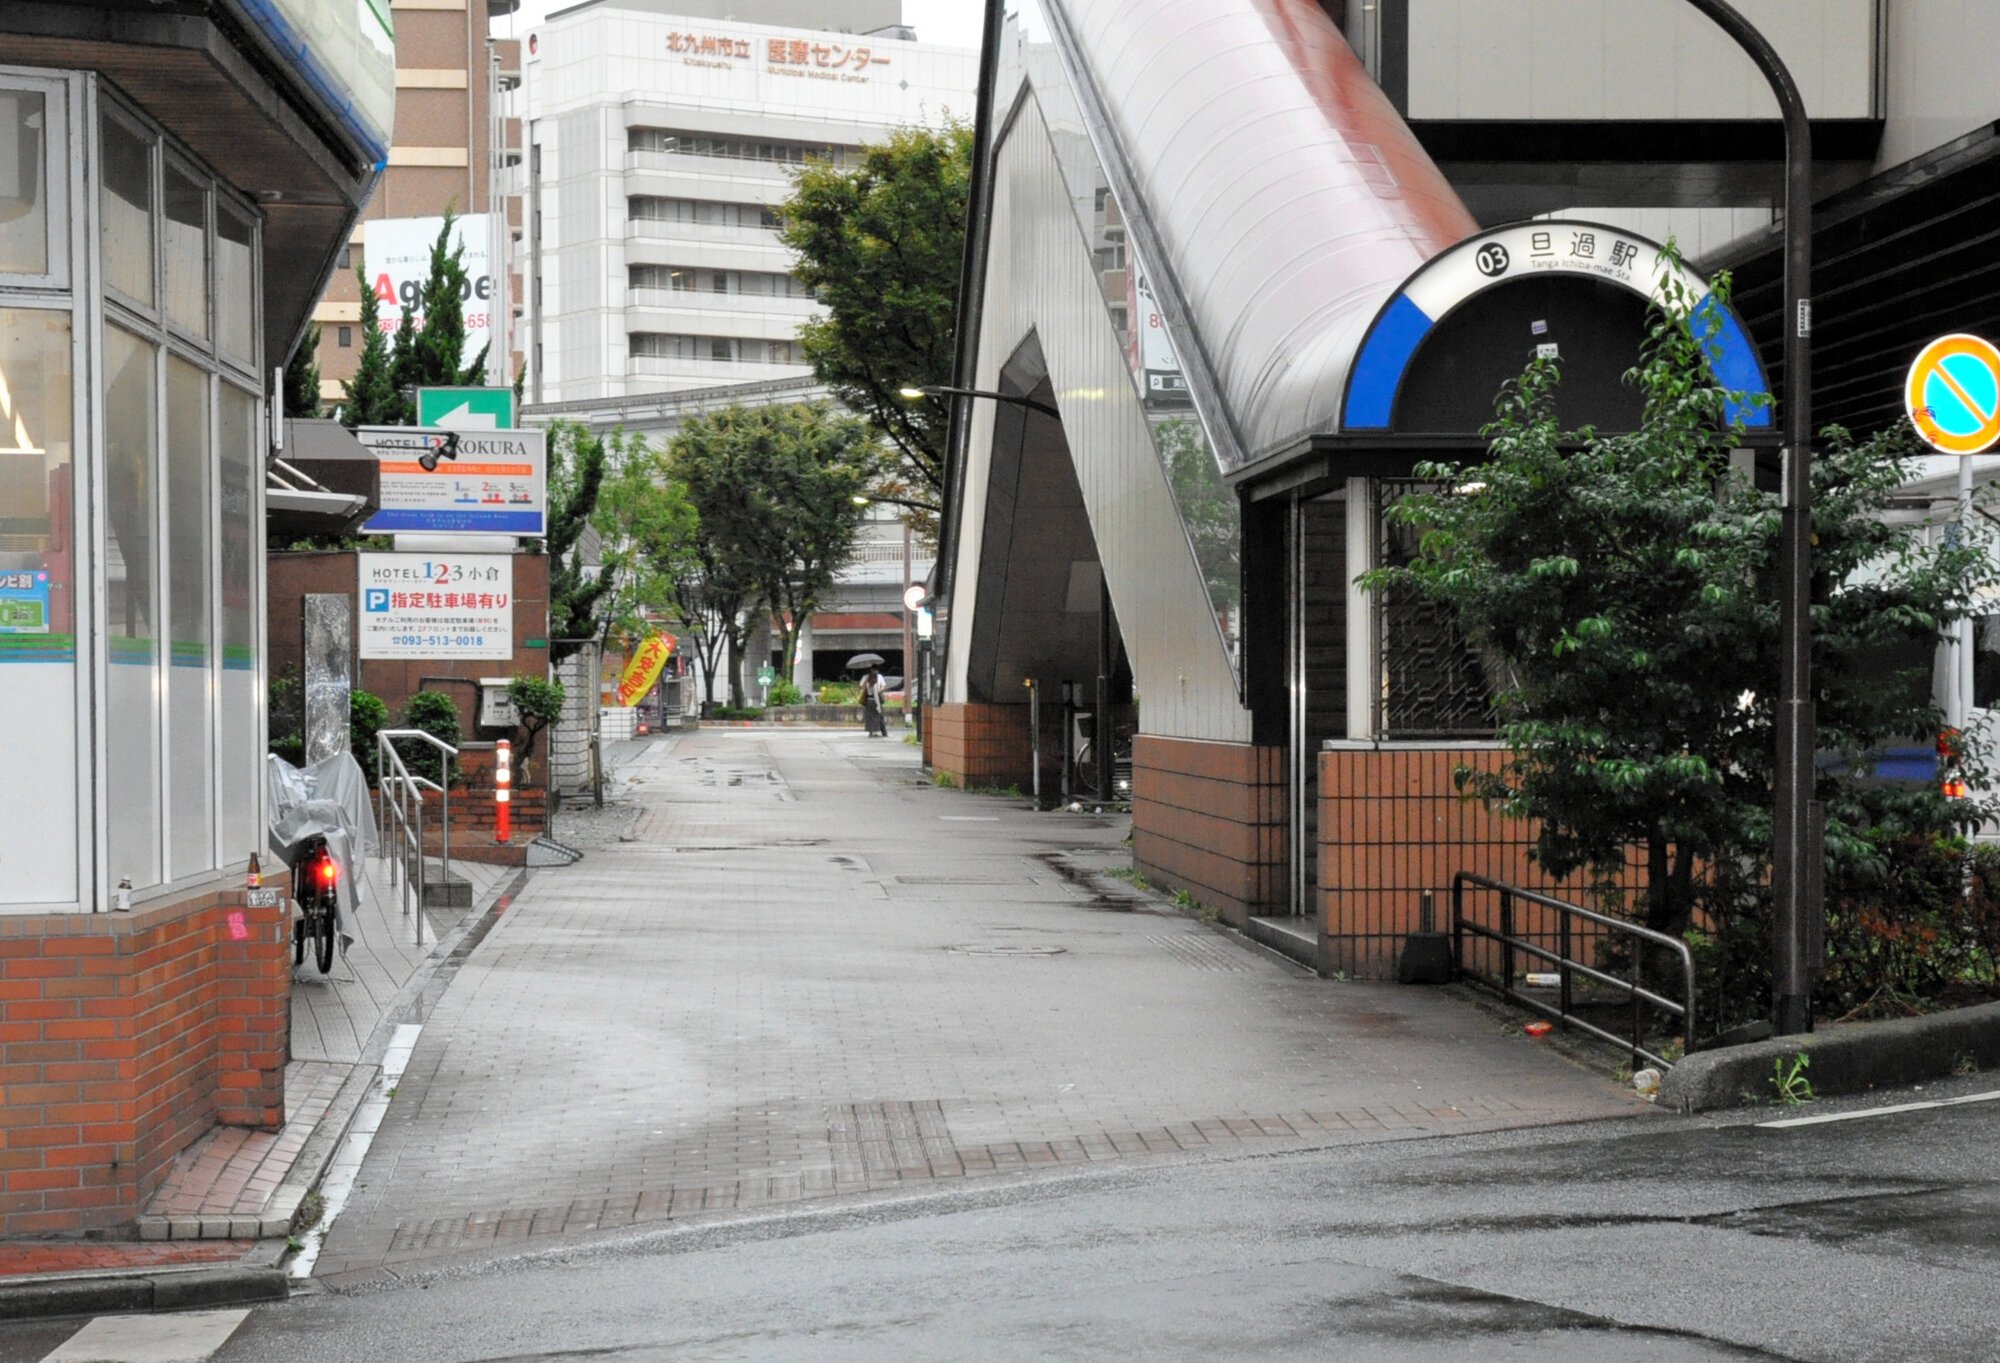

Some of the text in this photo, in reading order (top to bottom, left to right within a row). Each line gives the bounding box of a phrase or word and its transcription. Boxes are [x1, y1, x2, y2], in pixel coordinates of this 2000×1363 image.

[666, 31, 891, 71] 北九州市立 医療センター
[1477, 244, 1509, 276] 03
[1529, 231, 1639, 271] 旦過駅
[1531, 259, 1559, 270] Tanga
[1562, 258, 1614, 276] Ichiba-mae
[372, 568, 420, 579] HOTEL
[468, 566, 499, 581] 小倉
[391, 592, 508, 609] 指定駐車場有り
[401, 635, 484, 646] 093-513-0018
